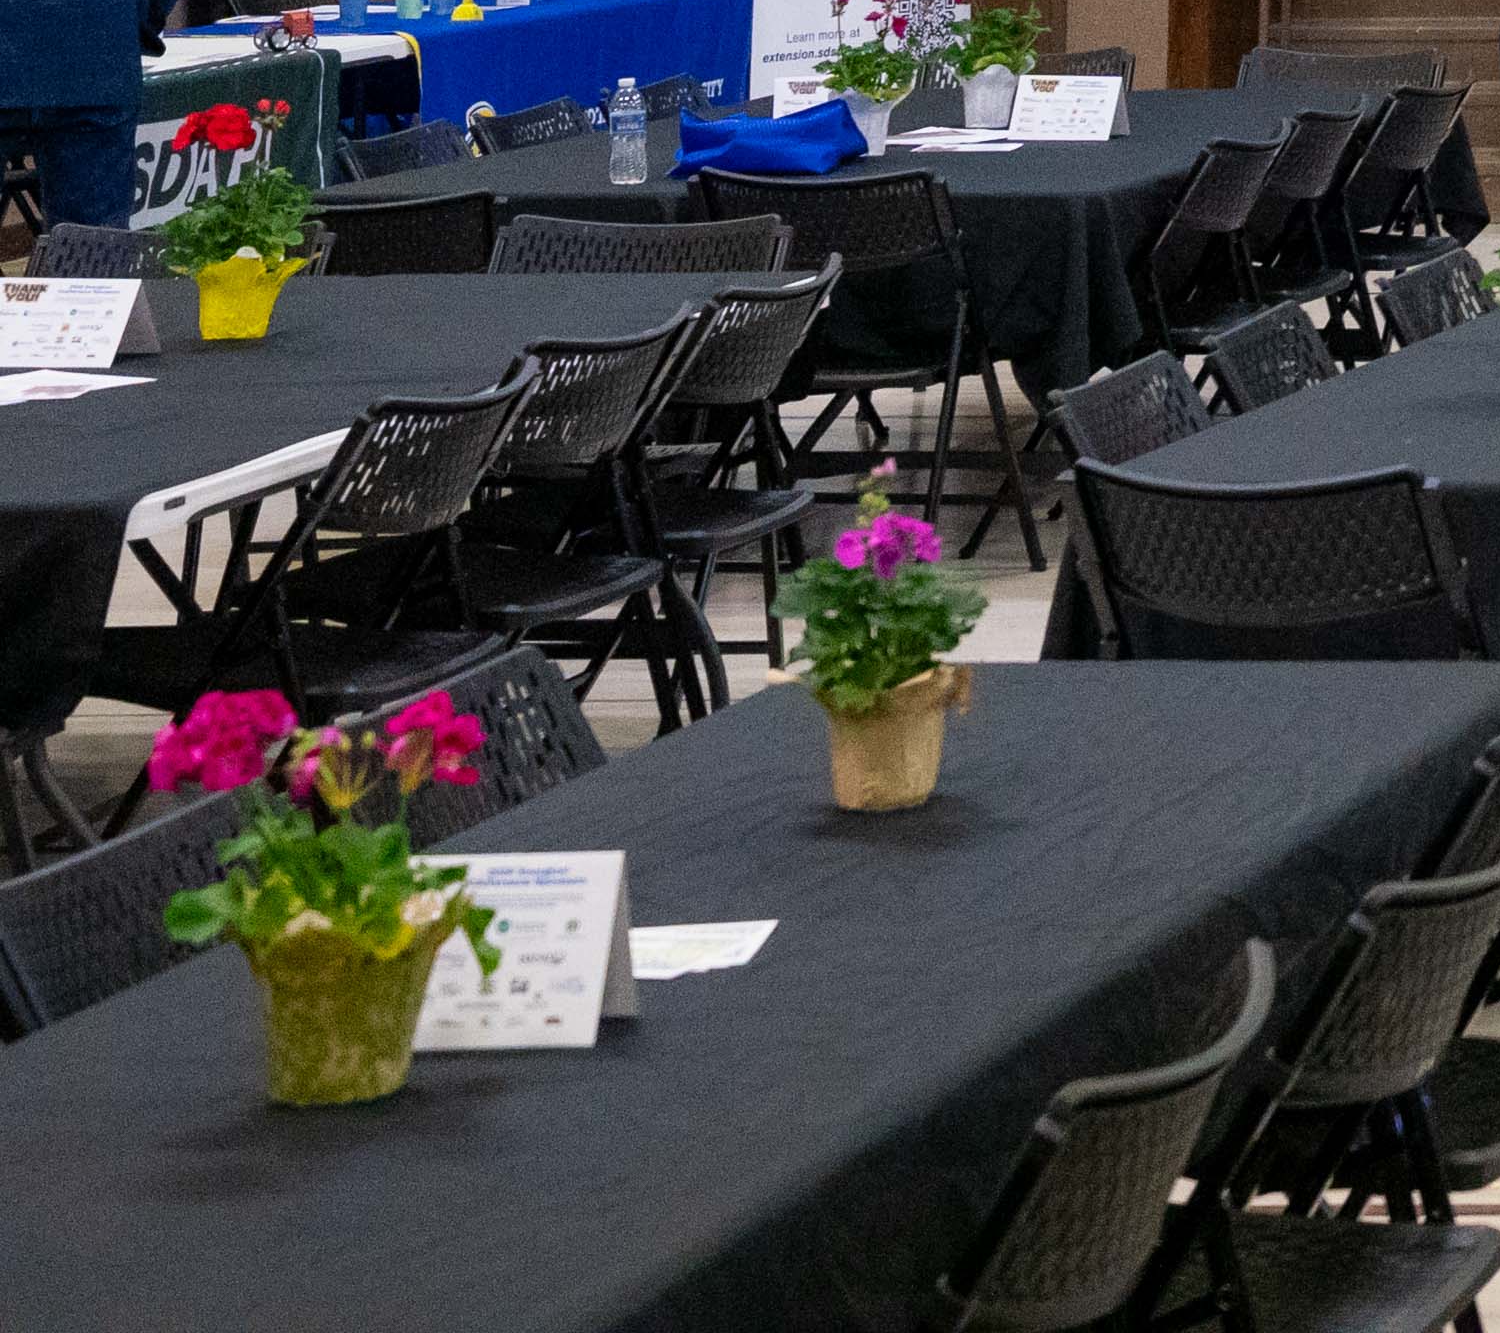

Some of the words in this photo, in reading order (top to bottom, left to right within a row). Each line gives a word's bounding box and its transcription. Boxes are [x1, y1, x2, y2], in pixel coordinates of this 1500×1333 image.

[786, 32, 815, 43] Learn
[818, 31, 847, 40] more
[850, 29, 860, 38] at
[4, 283, 48, 293] THANK
